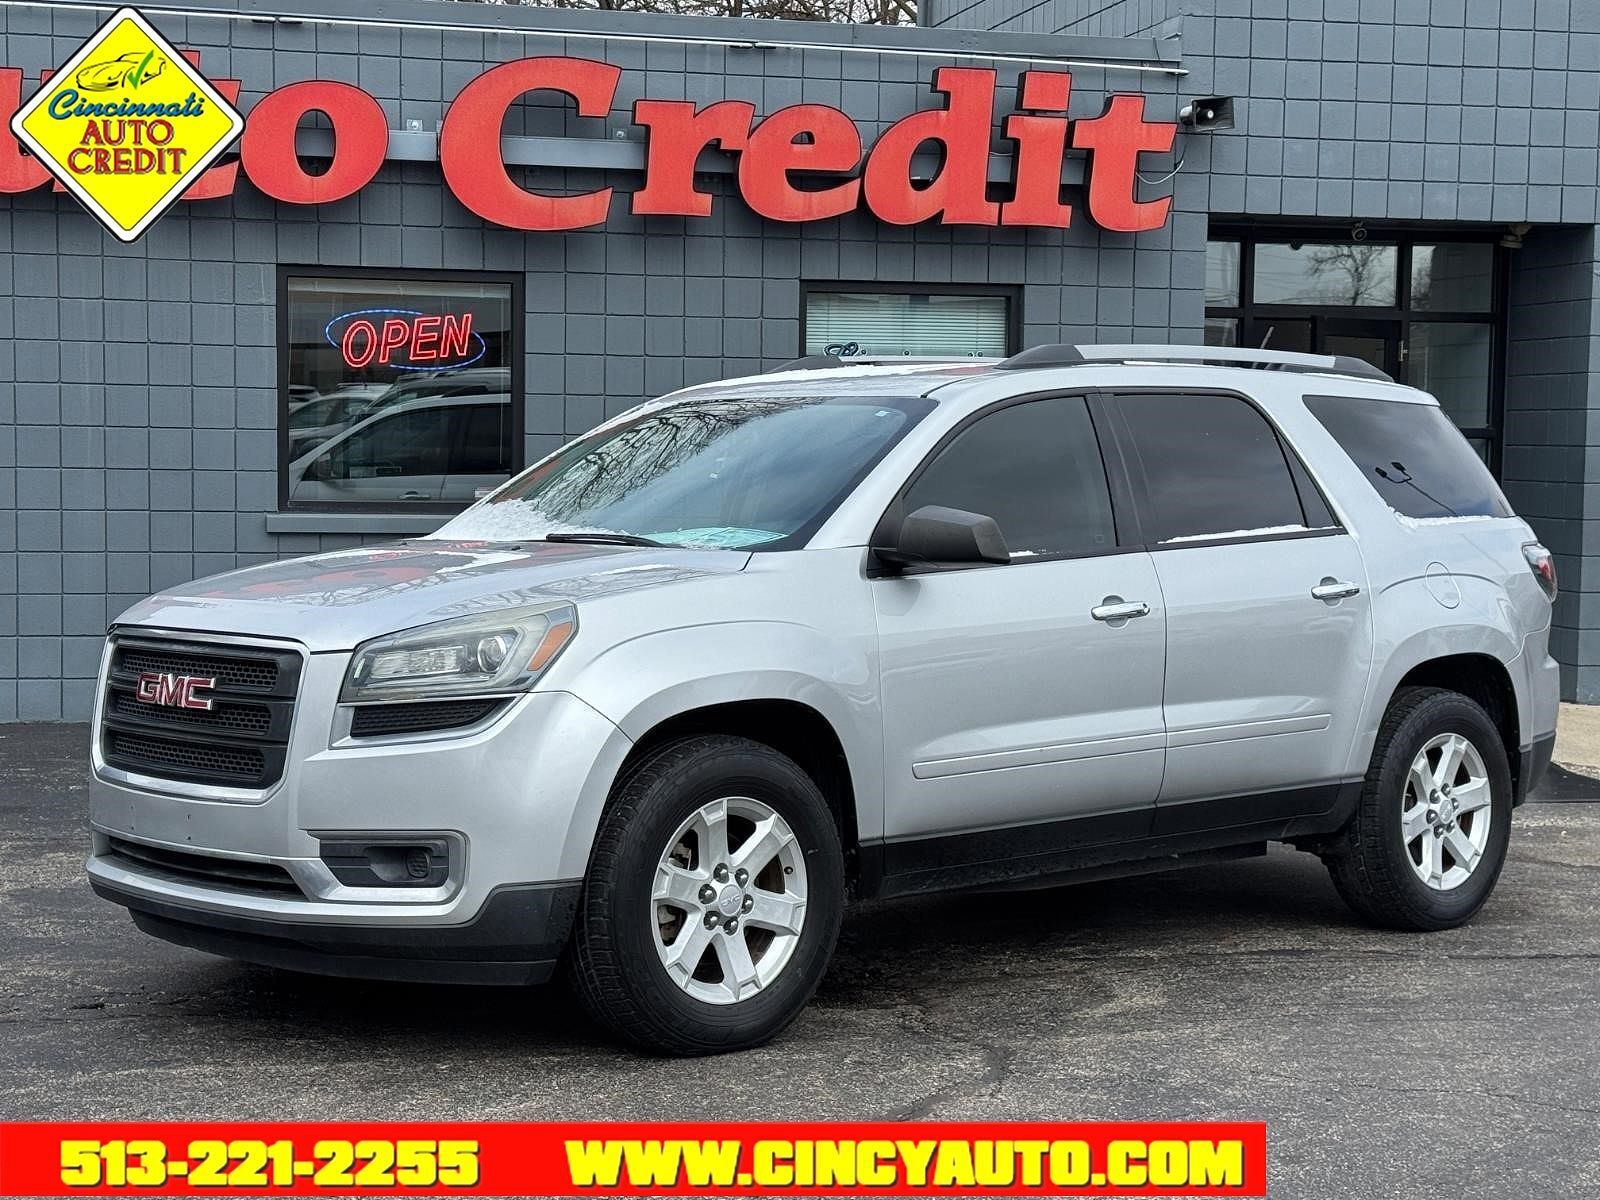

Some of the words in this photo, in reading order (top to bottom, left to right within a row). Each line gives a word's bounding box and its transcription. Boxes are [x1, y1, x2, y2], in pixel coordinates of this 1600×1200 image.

[440, 55, 1178, 232] Credit
[342, 313, 472, 368] OPEN
[136, 672, 216, 711] GMC
